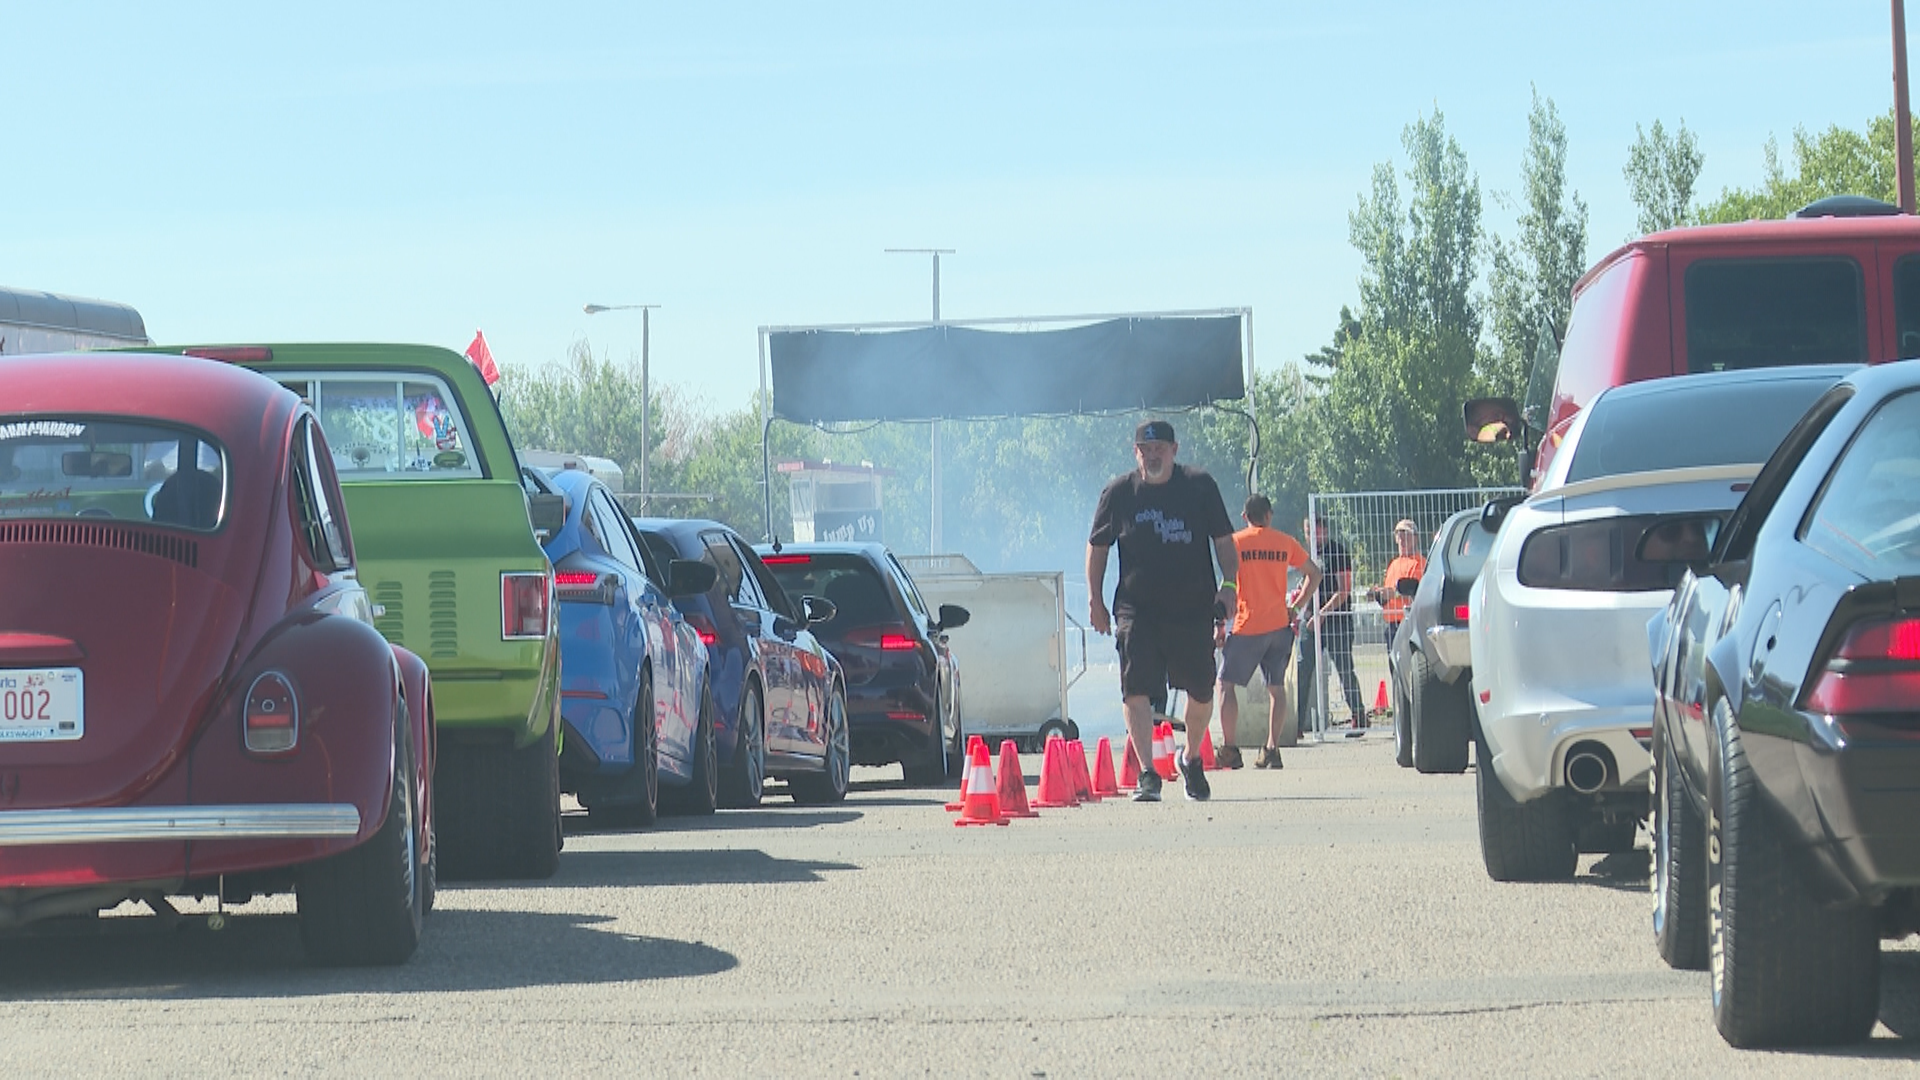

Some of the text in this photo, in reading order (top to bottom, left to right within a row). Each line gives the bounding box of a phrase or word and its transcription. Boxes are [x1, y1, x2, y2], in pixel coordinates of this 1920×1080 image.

[1241, 551, 1288, 562] MEMBER
[4, 689, 51, 720] 002
[1710, 808, 1721, 864] GT
